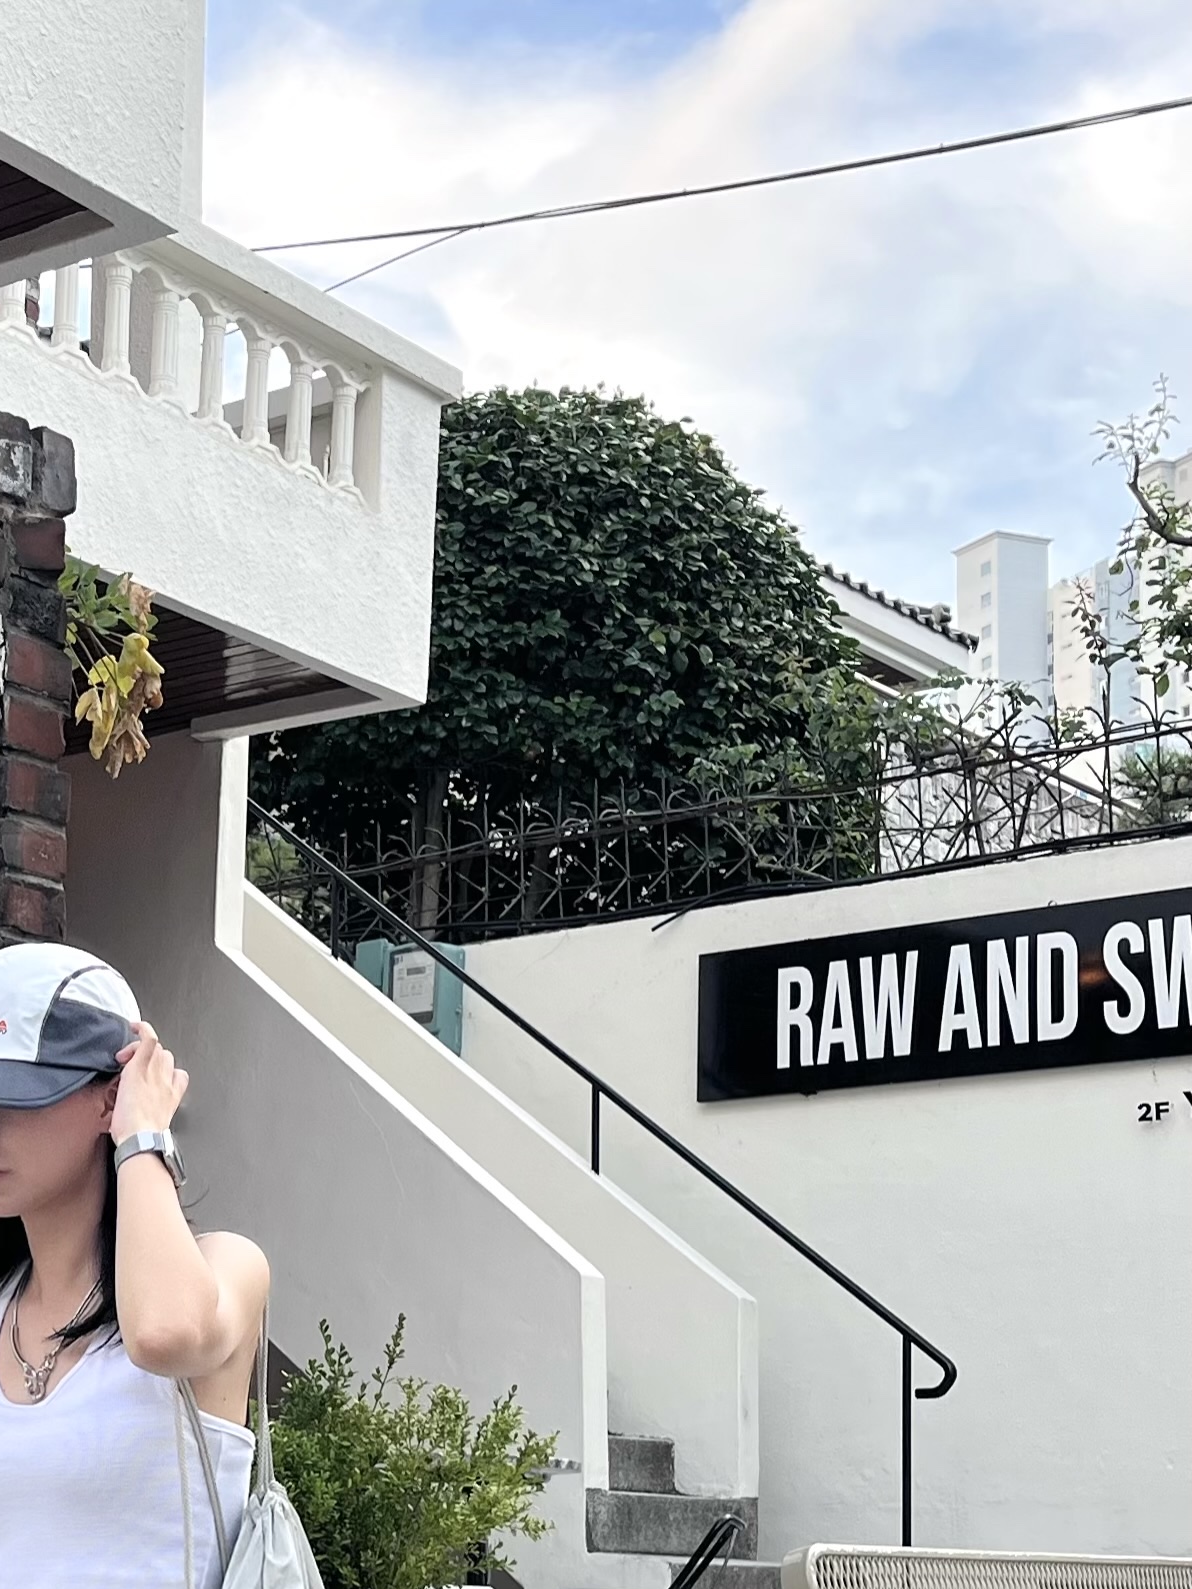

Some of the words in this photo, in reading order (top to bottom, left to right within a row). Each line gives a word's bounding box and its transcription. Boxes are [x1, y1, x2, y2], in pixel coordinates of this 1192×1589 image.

[777, 951, 919, 1069] RAW
[938, 931, 1079, 1052] AND
[1138, 1101, 1170, 1122] 2F
